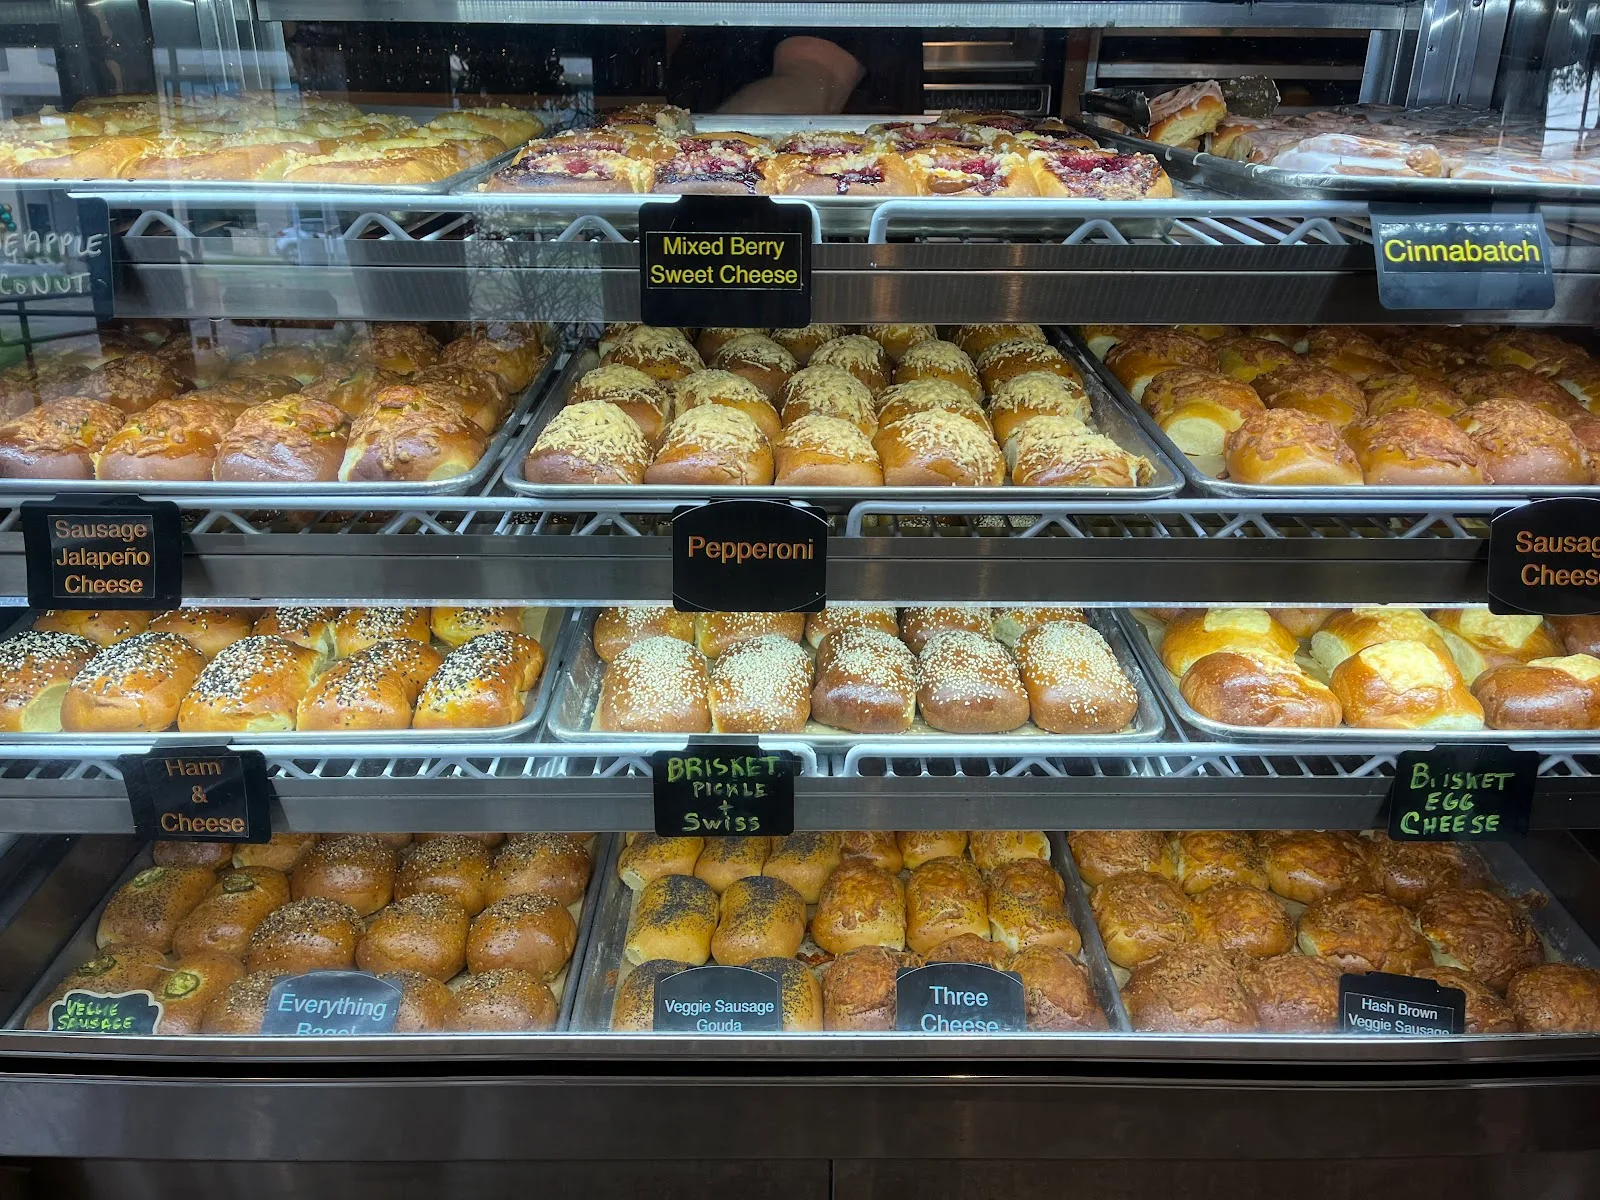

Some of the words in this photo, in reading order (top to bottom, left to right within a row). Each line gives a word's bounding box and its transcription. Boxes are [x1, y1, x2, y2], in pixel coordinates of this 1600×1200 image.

[0, 230, 108, 258] EAPPLE
[663, 236, 723, 256] Mixed
[730, 236, 785, 261] Berry
[1384, 239, 1541, 263] Cinnabatch
[650, 264, 714, 284] Sweet
[719, 264, 798, 284] Cheese
[55, 519, 148, 543] Sausage
[56, 547, 151, 570] Jalapeño
[688, 535, 814, 564] Pepperoni
[64, 574, 143, 594] Cheese
[1521, 563, 1600, 586] Chees
[164, 758, 222, 777] Ham
[667, 756, 780, 783] BRISKET
[1409, 761, 1516, 791] BISKET
[191, 785, 209, 804] &
[692, 781, 768, 799] PICKLE
[1424, 791, 1475, 812] EGG
[161, 812, 245, 833] Cheese
[1400, 811, 1500, 836] CHEESE
[277, 993, 388, 1021] Everything
[928, 985, 989, 1007] Three
[664, 999, 712, 1017] Veggie
[714, 999, 775, 1016] Sausage
[1361, 997, 1395, 1014] Hash
[1397, 1002, 1438, 1020] Brown
[696, 1018, 743, 1032] Gouda
[920, 1013, 999, 1033] Cheese
[1348, 1012, 1392, 1033] Veggie
